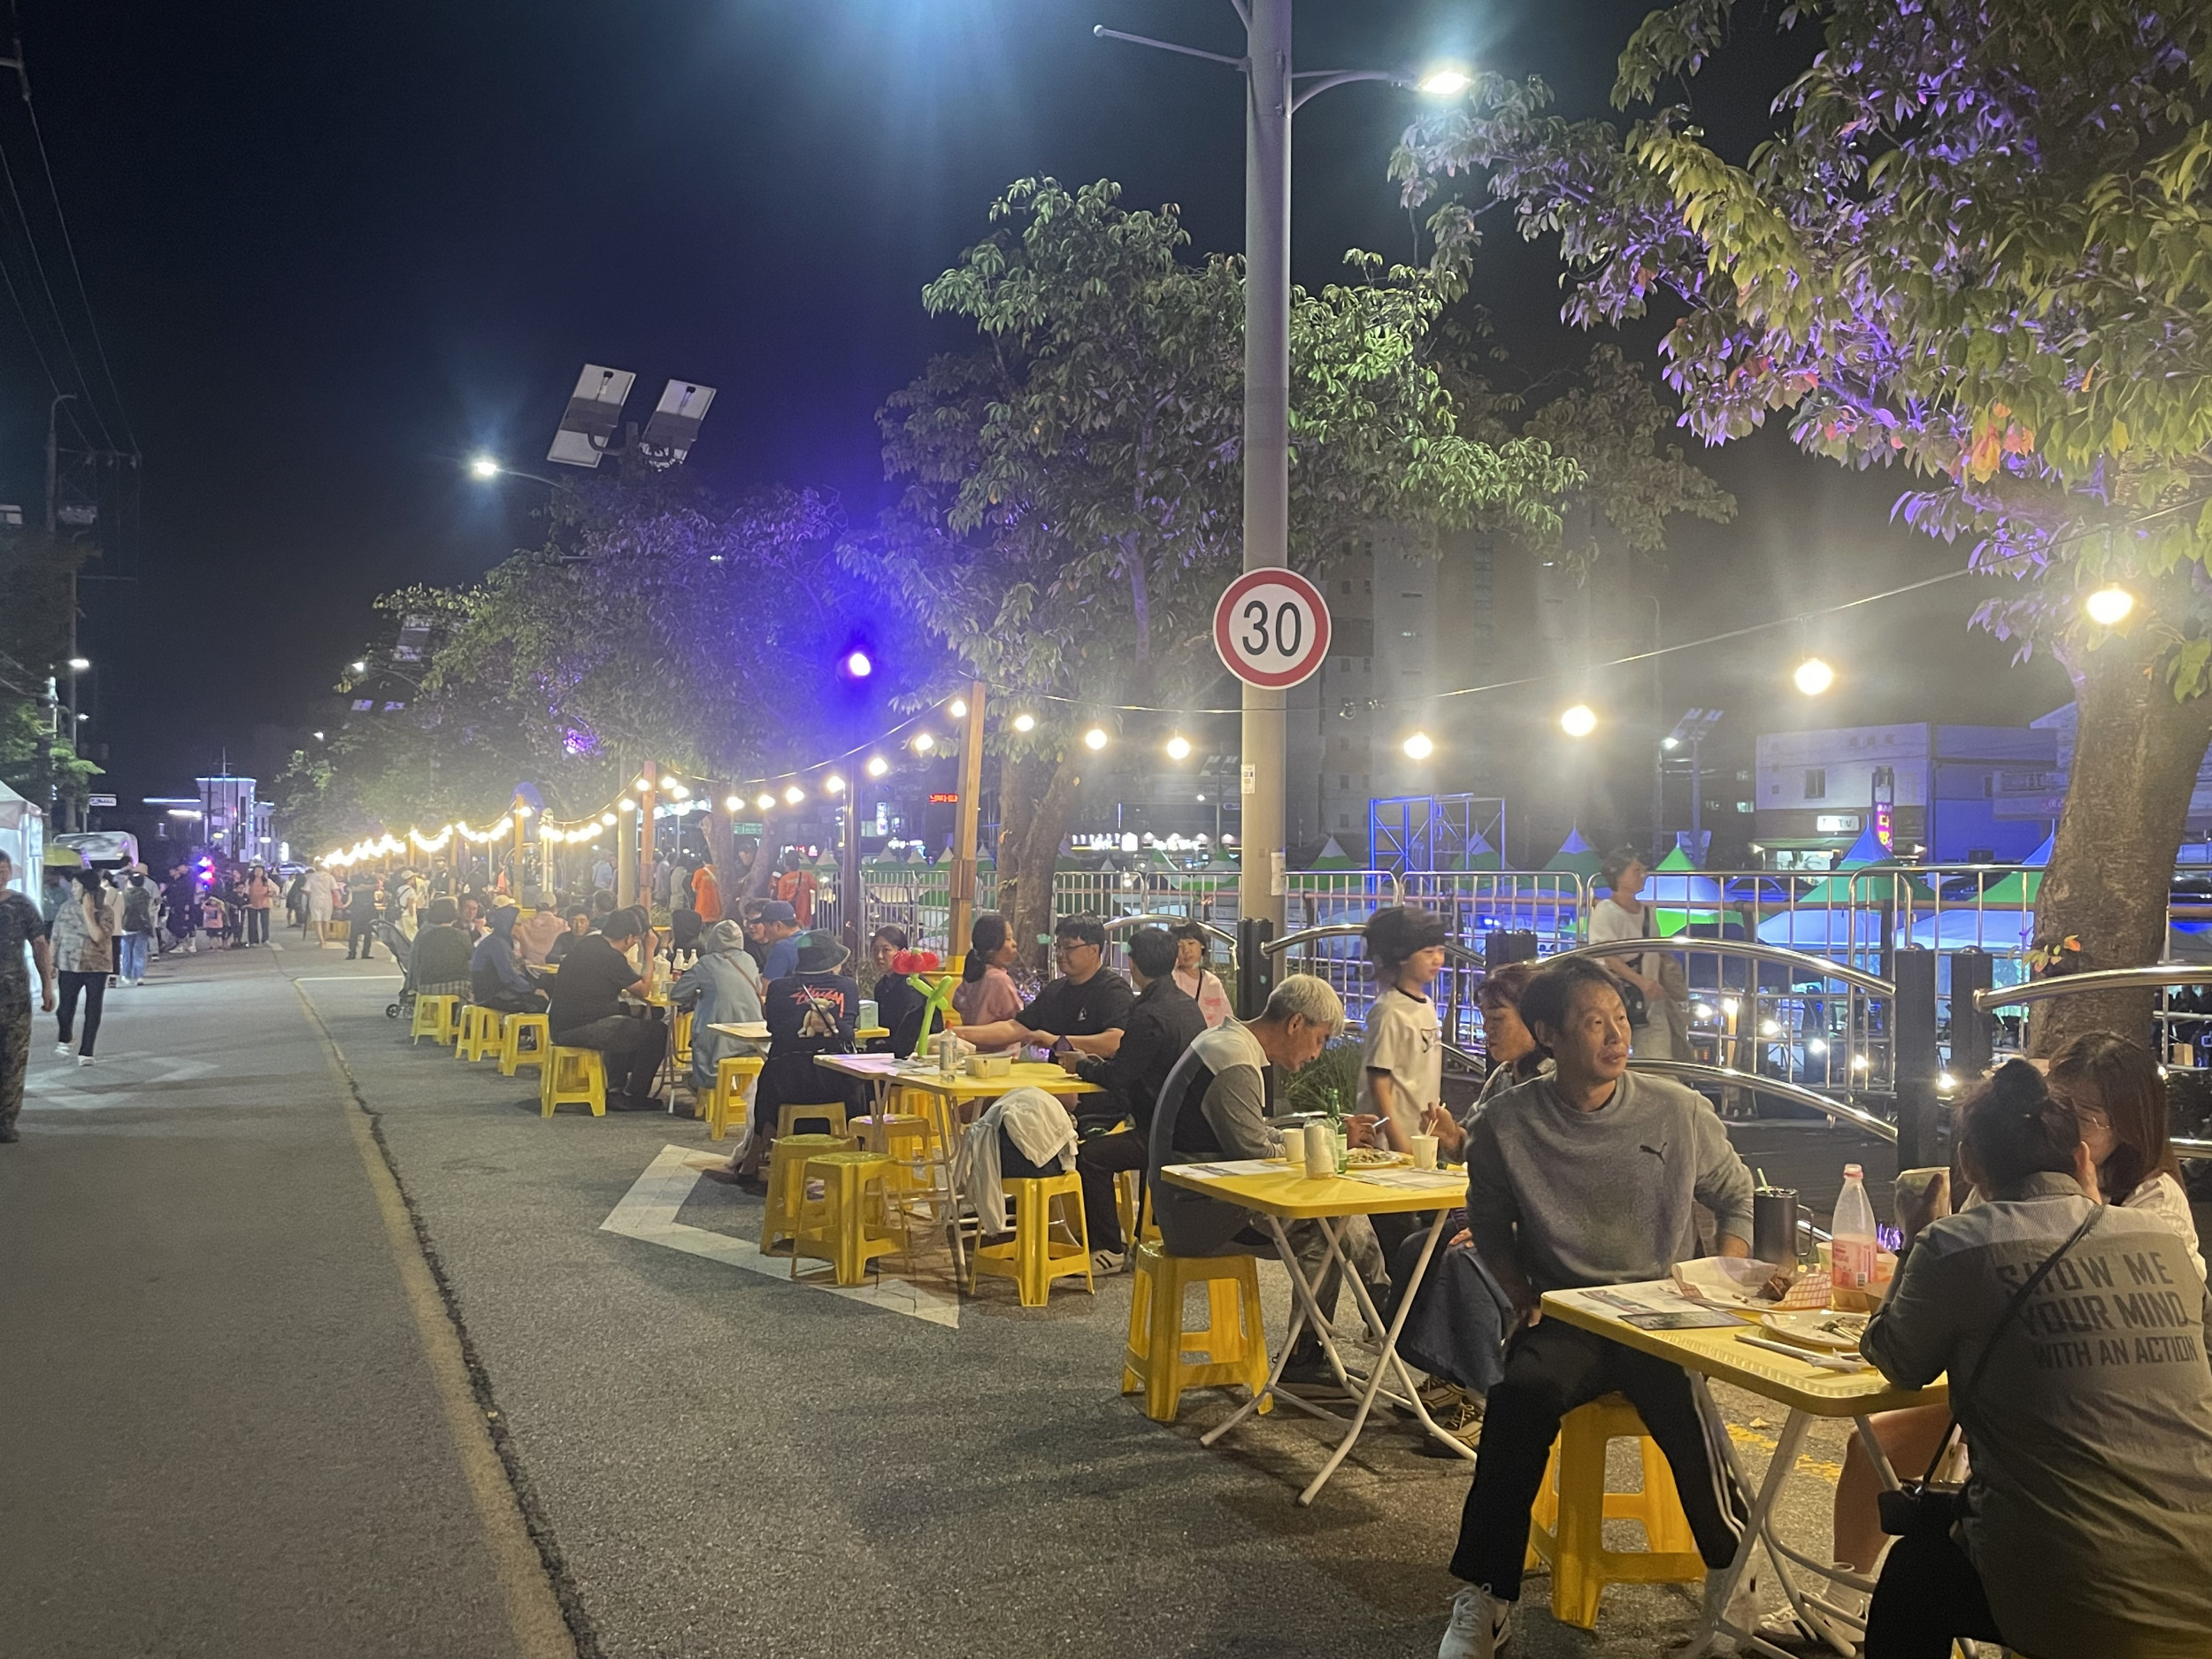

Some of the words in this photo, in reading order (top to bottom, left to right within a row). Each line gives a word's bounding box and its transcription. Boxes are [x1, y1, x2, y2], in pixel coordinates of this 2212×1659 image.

[1242, 600, 1302, 657] 30
[2124, 1251, 2174, 1286] ME
[2020, 1294, 2116, 1337] YOUR
[2113, 1291, 2189, 1329] MIND
[2036, 1340, 2093, 1370] WITH
[2100, 1338, 2130, 1366] AN
[2135, 1335, 2200, 1364] ACTION
